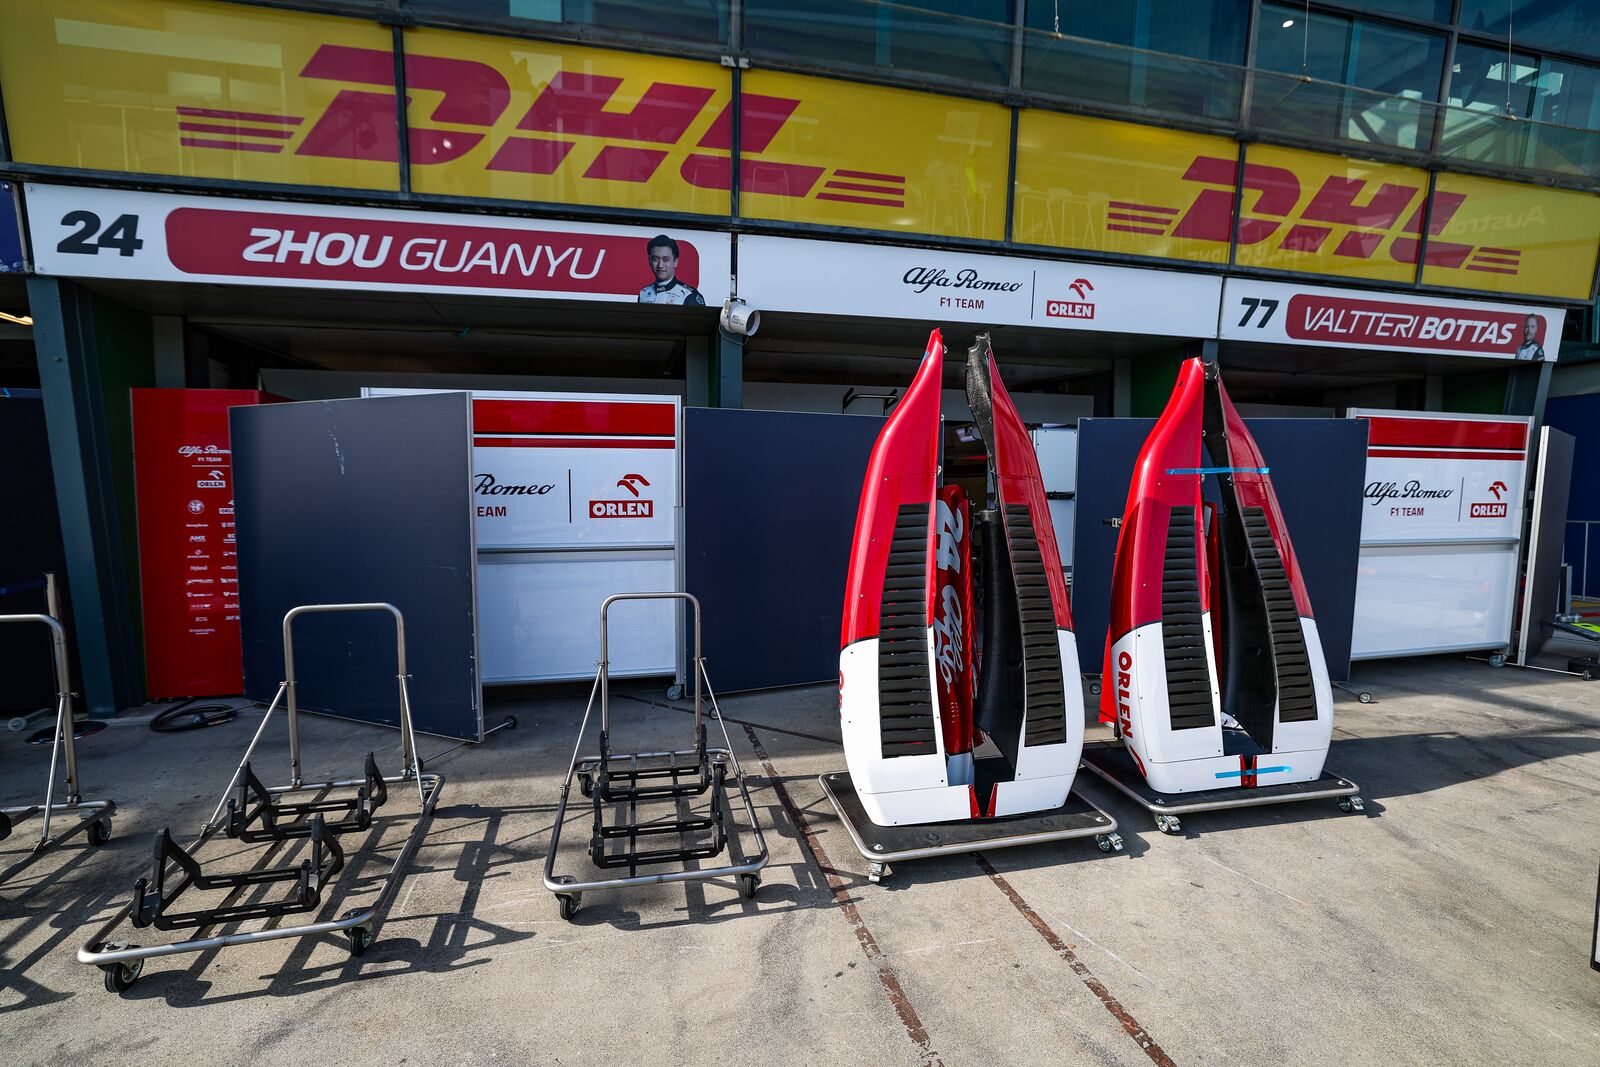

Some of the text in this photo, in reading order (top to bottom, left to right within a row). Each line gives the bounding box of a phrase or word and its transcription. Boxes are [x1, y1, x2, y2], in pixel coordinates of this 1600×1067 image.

[294, 43, 826, 198] DHL
[1171, 155, 1475, 269] DHL
[56, 210, 143, 257] 24
[242, 227, 606, 280] ZHOU GUANYU
[902, 266, 1023, 293] Alfa Romeo
[939, 297, 985, 310] F1 TEAM
[1048, 303, 1093, 319] ORLEN
[1238, 298, 1279, 328] 77
[1303, 305, 1517, 345] VALTTERI BOTTAS
[474, 473, 555, 495] Romeo
[1364, 480, 1454, 505] Alfa Romeo
[477, 506, 506, 517] EAM
[592, 503, 649, 516] ORLEN
[1390, 507, 1424, 517] F1 TEAM
[1471, 505, 1506, 517] ORLEN
[936, 500, 963, 574] 24
[1118, 651, 1134, 739] ORLEN
